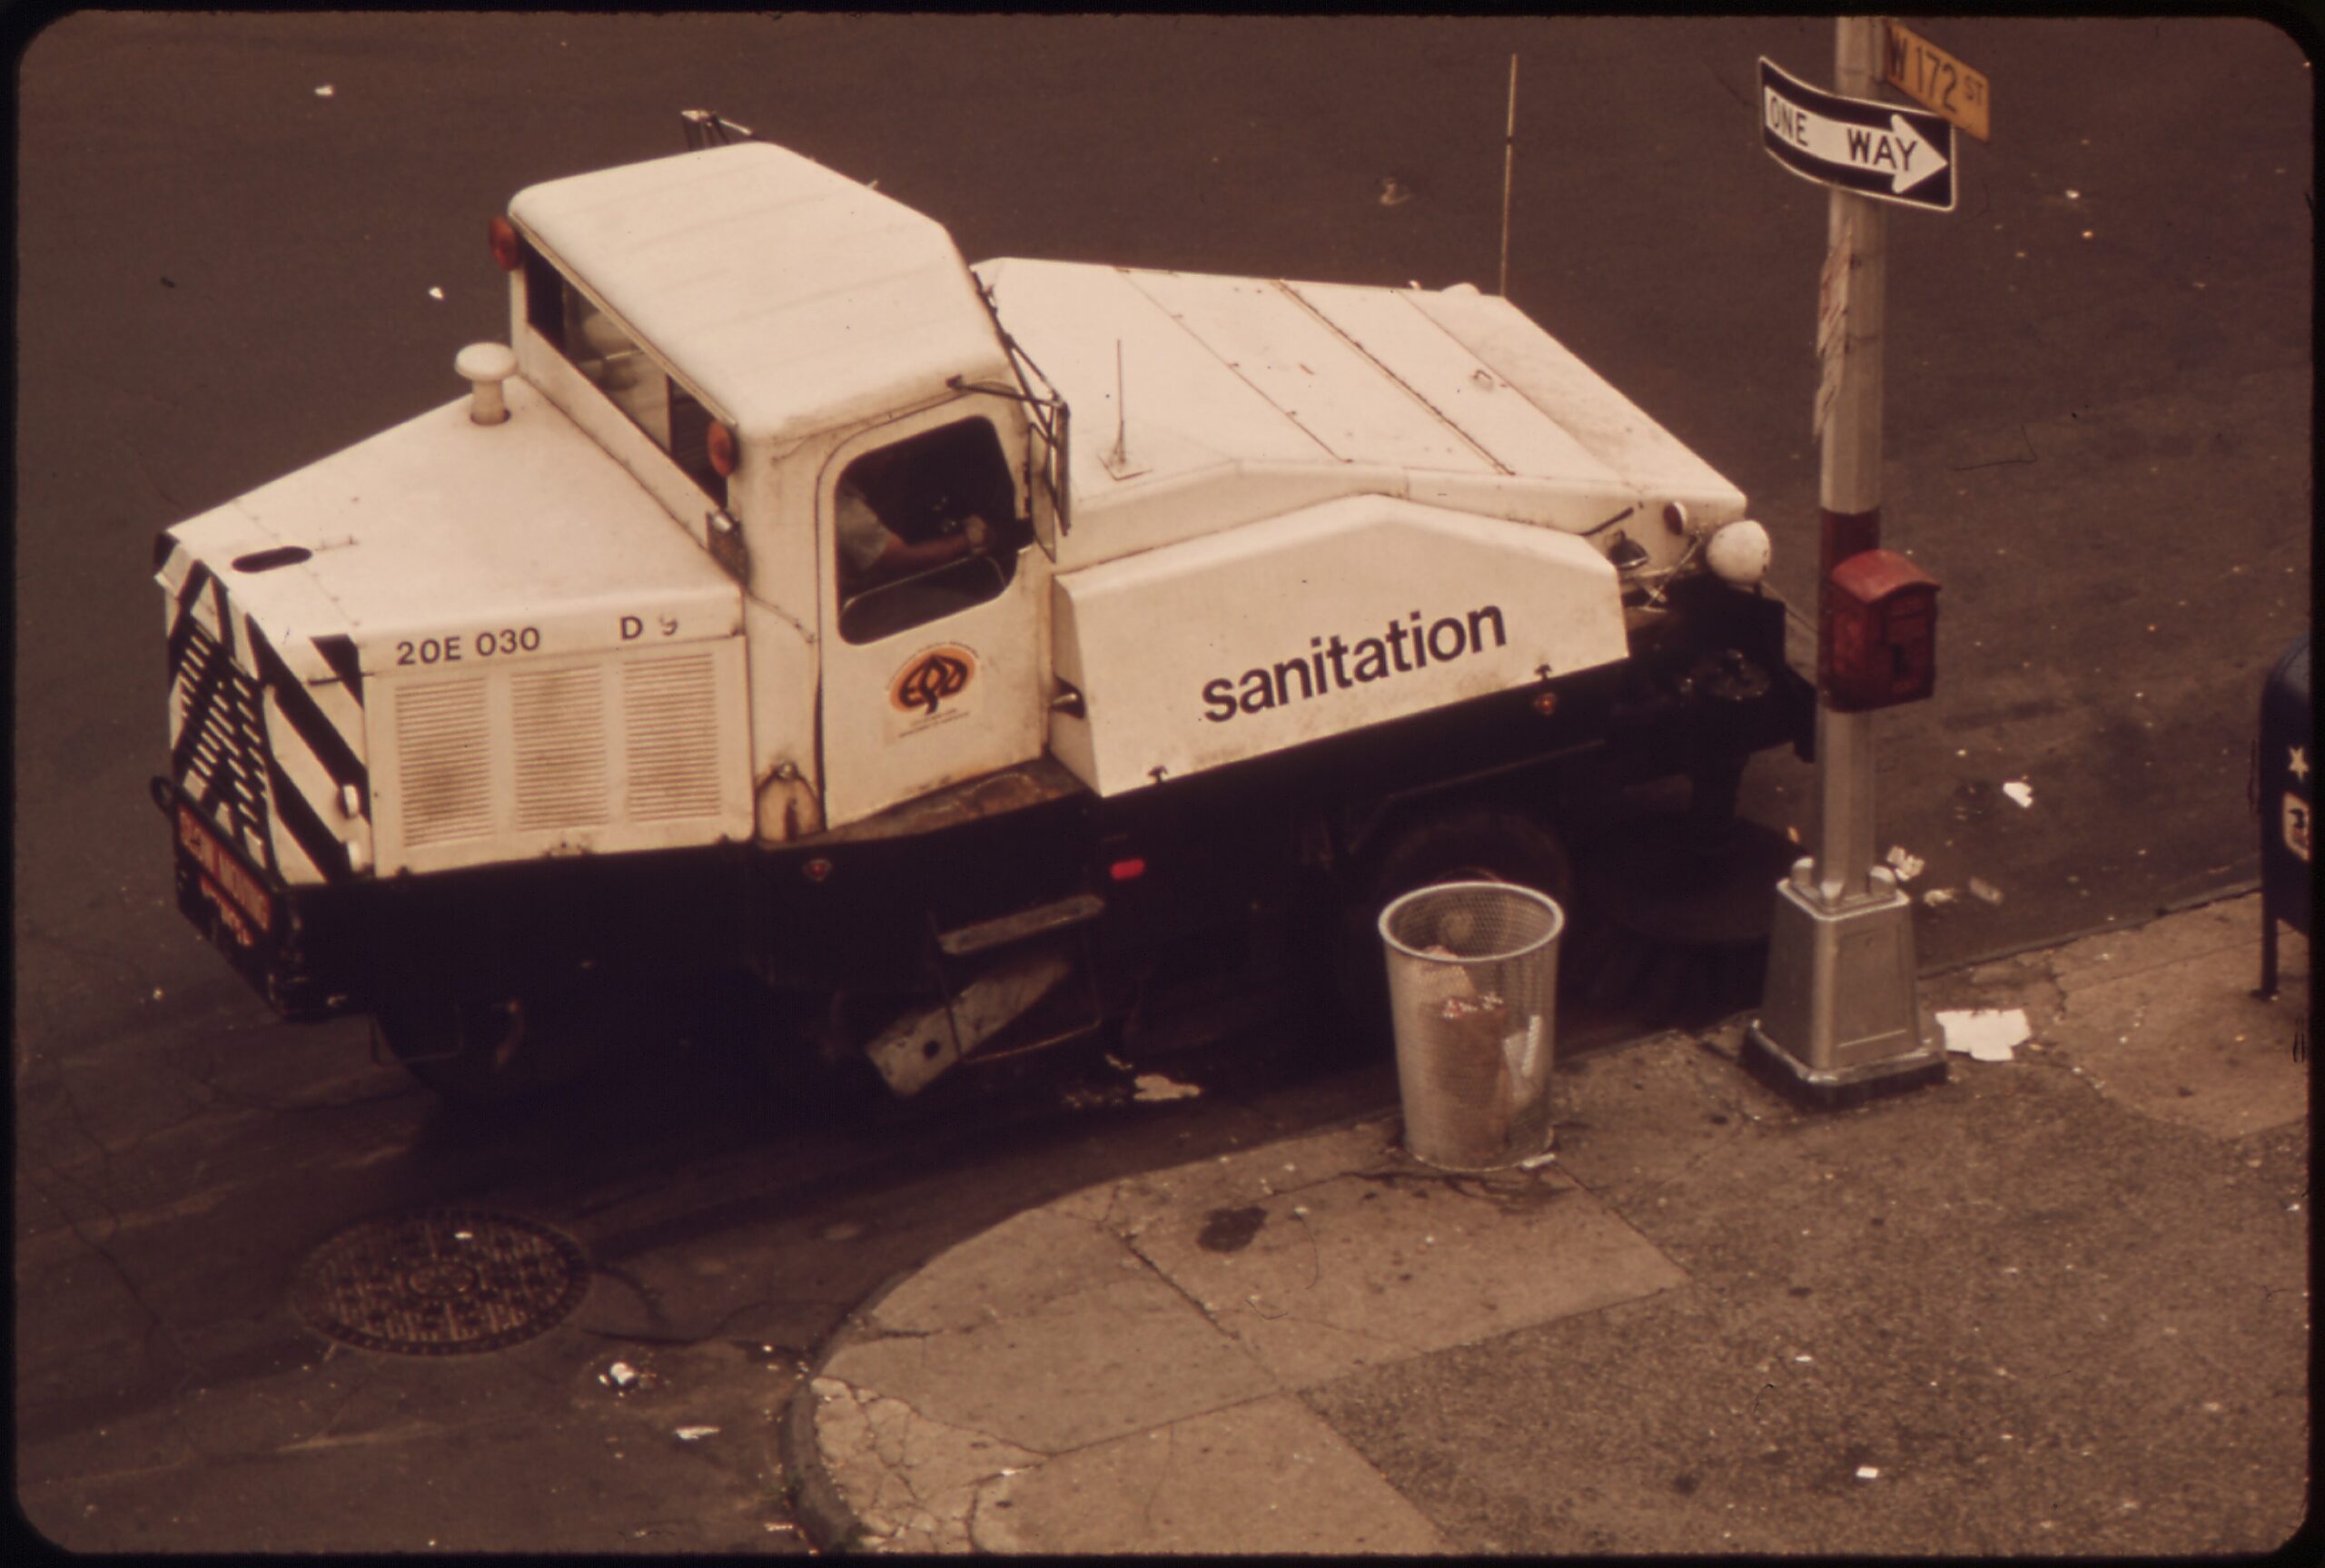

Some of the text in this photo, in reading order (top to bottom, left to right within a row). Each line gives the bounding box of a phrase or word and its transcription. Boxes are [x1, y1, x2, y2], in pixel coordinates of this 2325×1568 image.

[1915, 44, 1958, 113] 172
[1964, 74, 1984, 107] ST
[1768, 94, 1917, 173] ONE WAY
[397, 636, 462, 666] 20E
[475, 626, 541, 657] 030
[619, 615, 644, 640] D
[1201, 604, 1508, 724] sanitation
